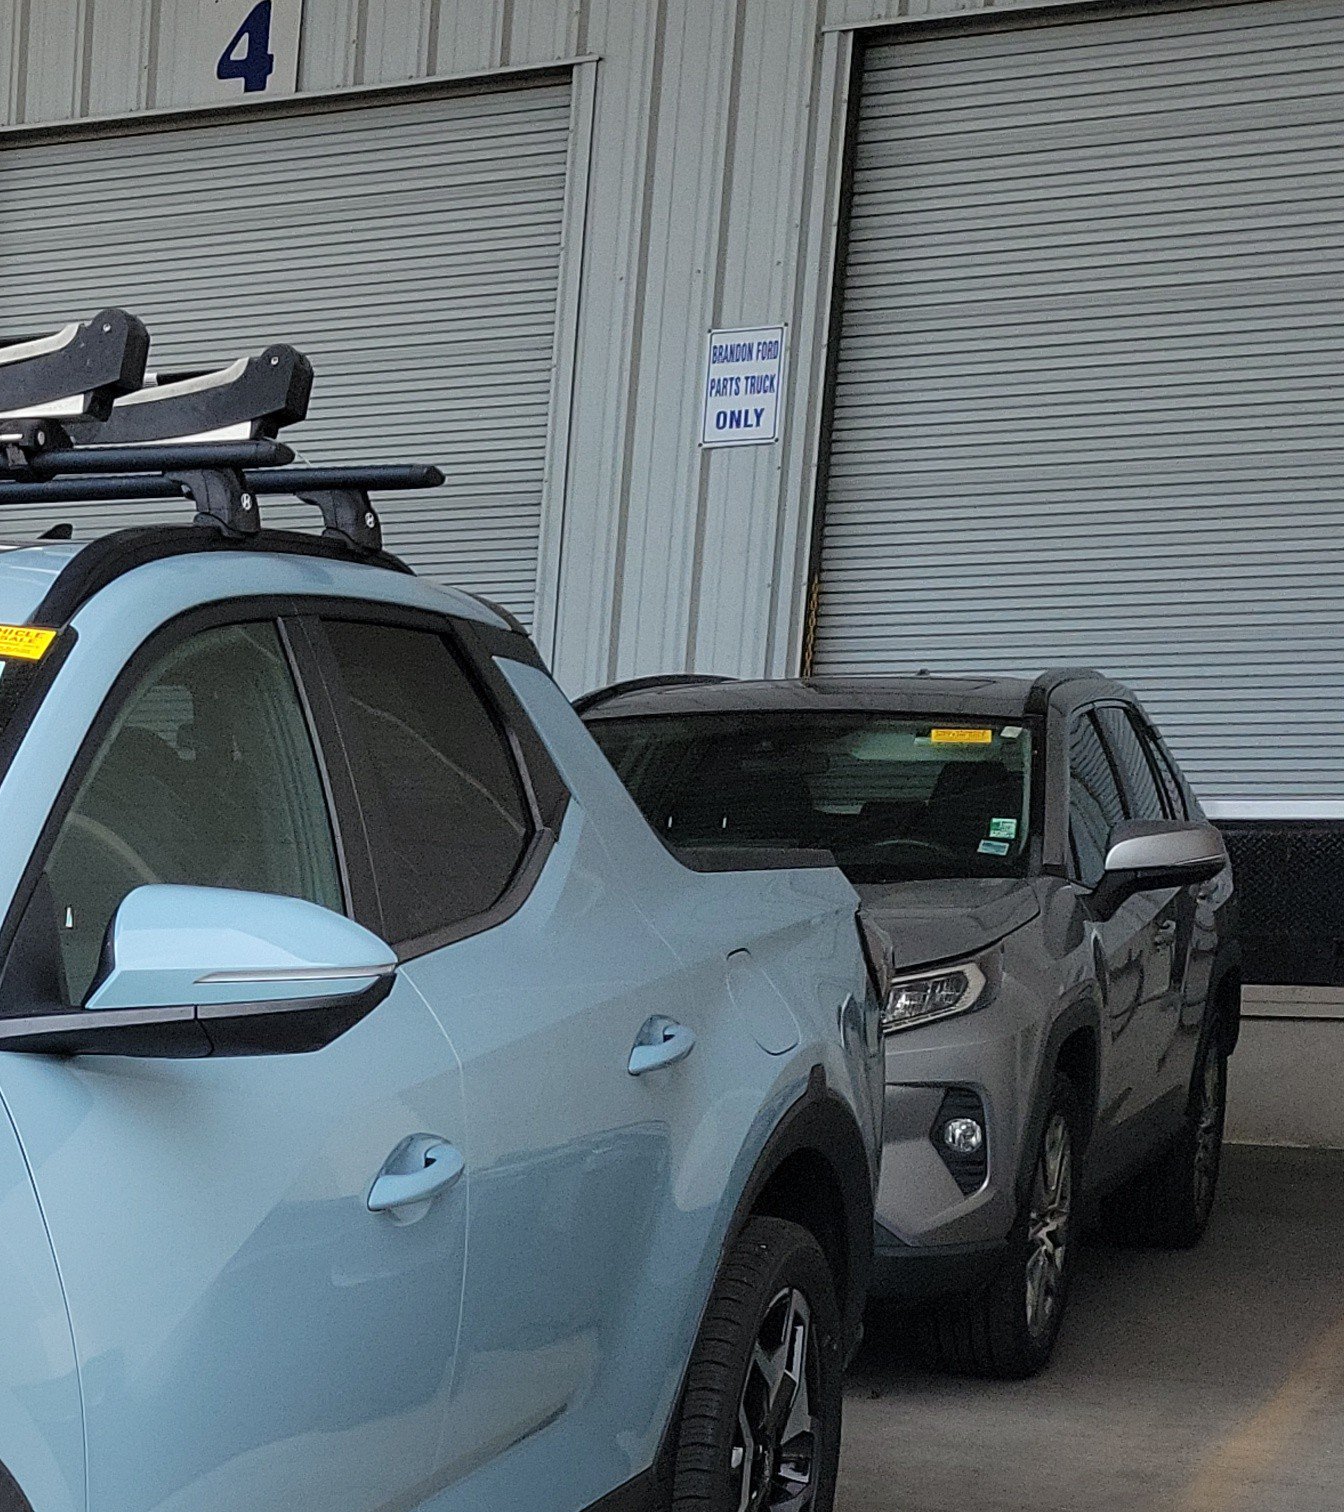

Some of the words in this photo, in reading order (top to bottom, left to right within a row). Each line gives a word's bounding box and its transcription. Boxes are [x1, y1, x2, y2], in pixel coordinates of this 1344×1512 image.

[217, 0, 274, 92] 4
[712, 342, 754, 364] BRANDON
[756, 340, 779, 361] FORD
[709, 376, 741, 397] PARTS
[744, 373, 776, 395] TRUCK
[715, 408, 765, 430] ONLY
[0, 634, 38, 643] SALE
